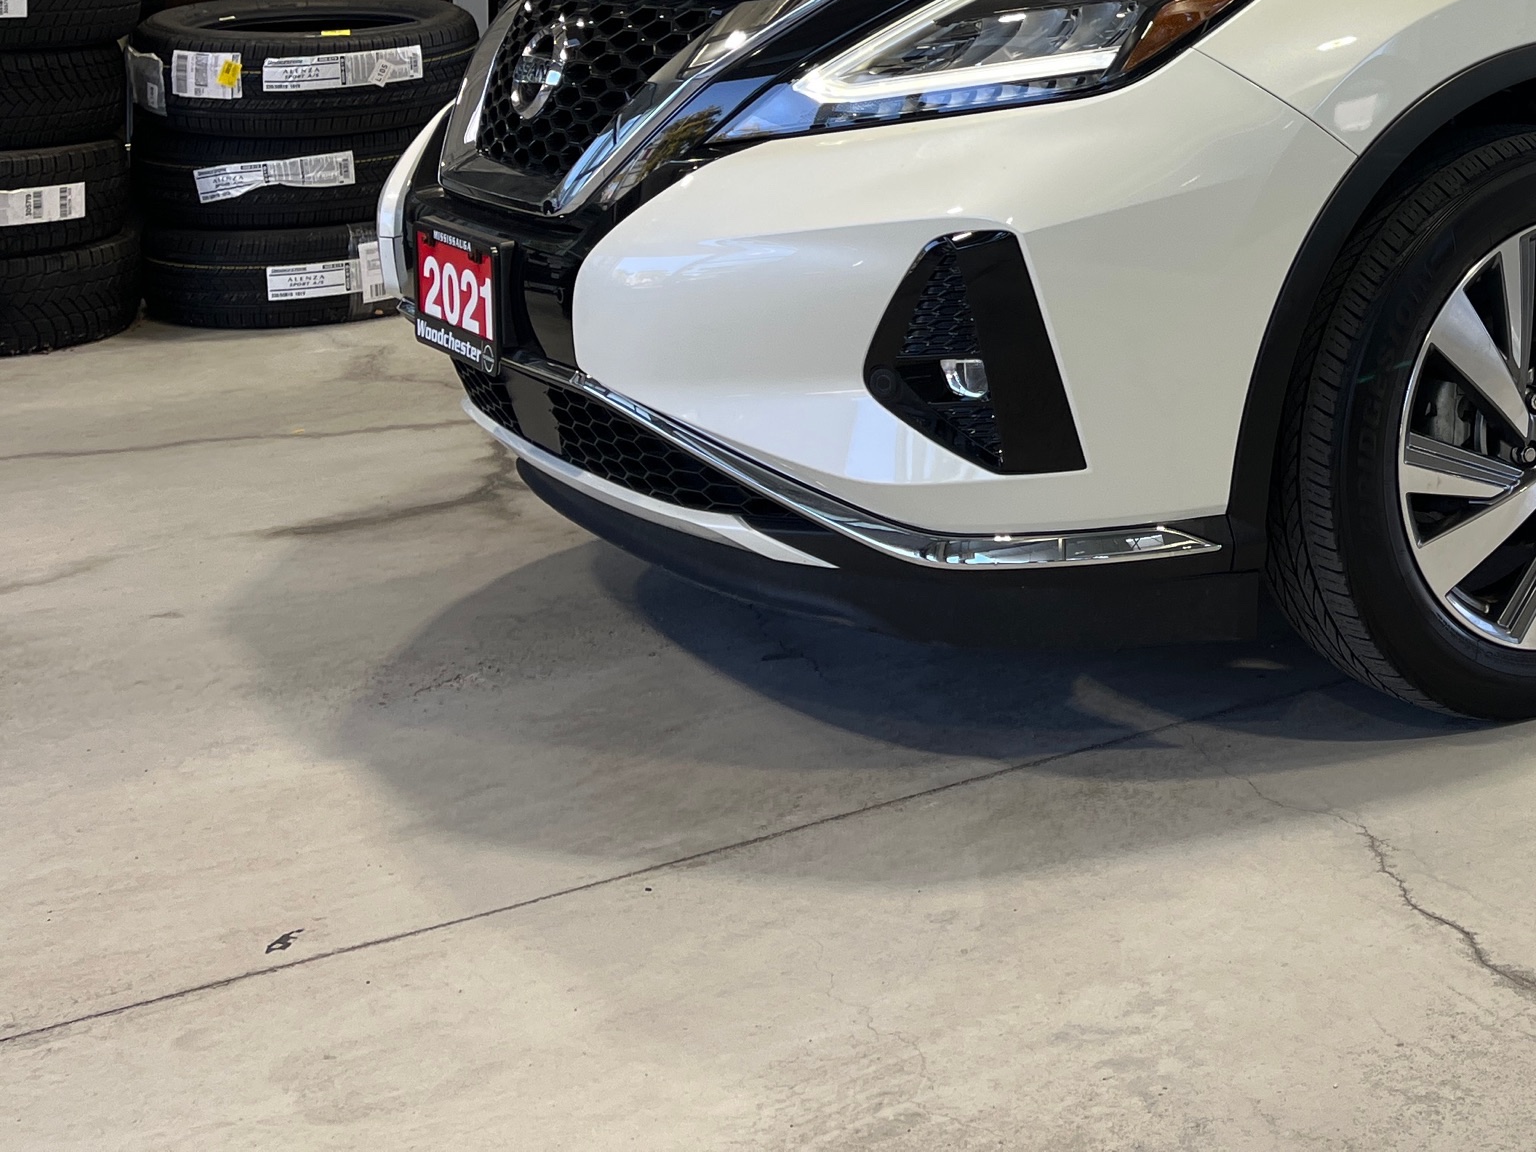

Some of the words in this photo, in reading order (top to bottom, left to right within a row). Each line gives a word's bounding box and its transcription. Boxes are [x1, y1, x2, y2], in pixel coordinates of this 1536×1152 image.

[283, 68, 321, 76] ALENZA
[375, 64, 389, 82] L105
[432, 229, 472, 252] MISSISSAUGA
[287, 274, 326, 283] ALENZA
[423, 255, 494, 342] 2021
[416, 318, 482, 364] Woodchester
